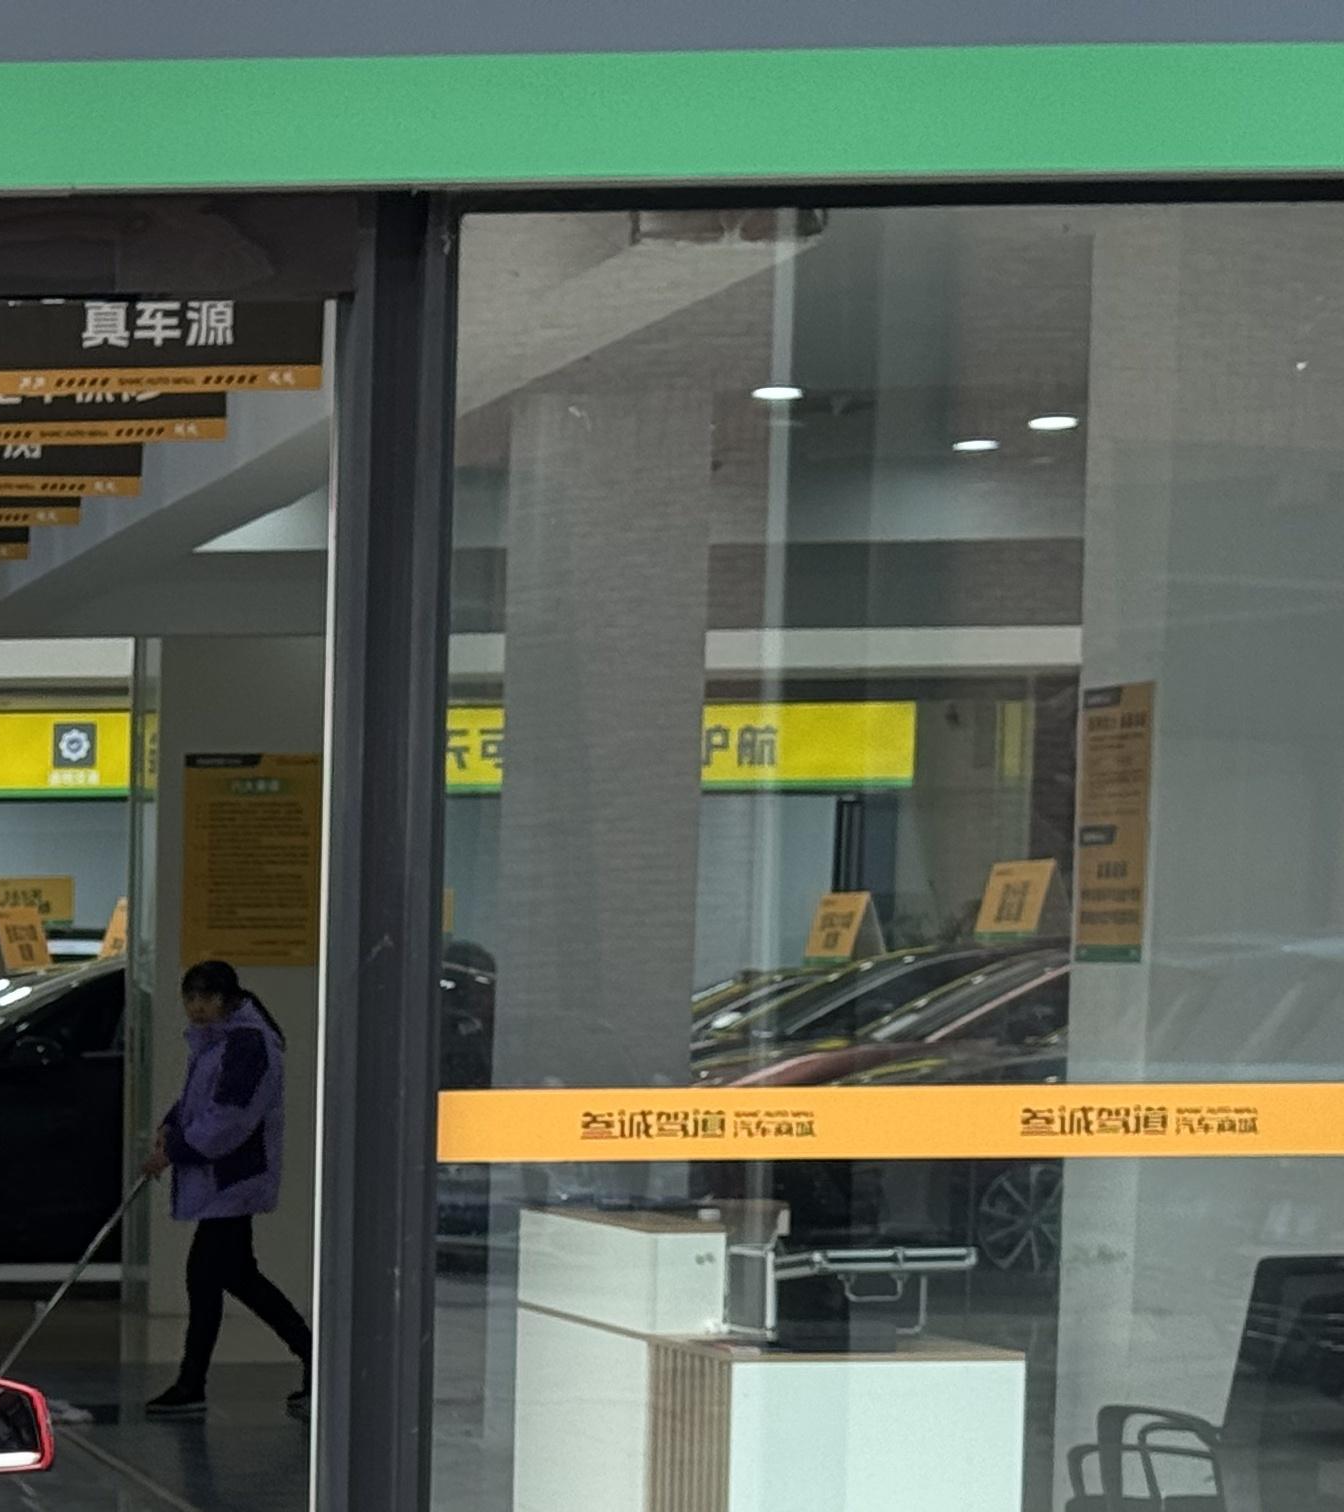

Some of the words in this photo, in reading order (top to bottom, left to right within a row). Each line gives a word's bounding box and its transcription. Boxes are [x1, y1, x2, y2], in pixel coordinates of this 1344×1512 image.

[81, 300, 234, 348] 真车源
[581, 1109, 726, 1139] 叁诚驾道
[1020, 1105, 1168, 1136] 叁诚驾道
